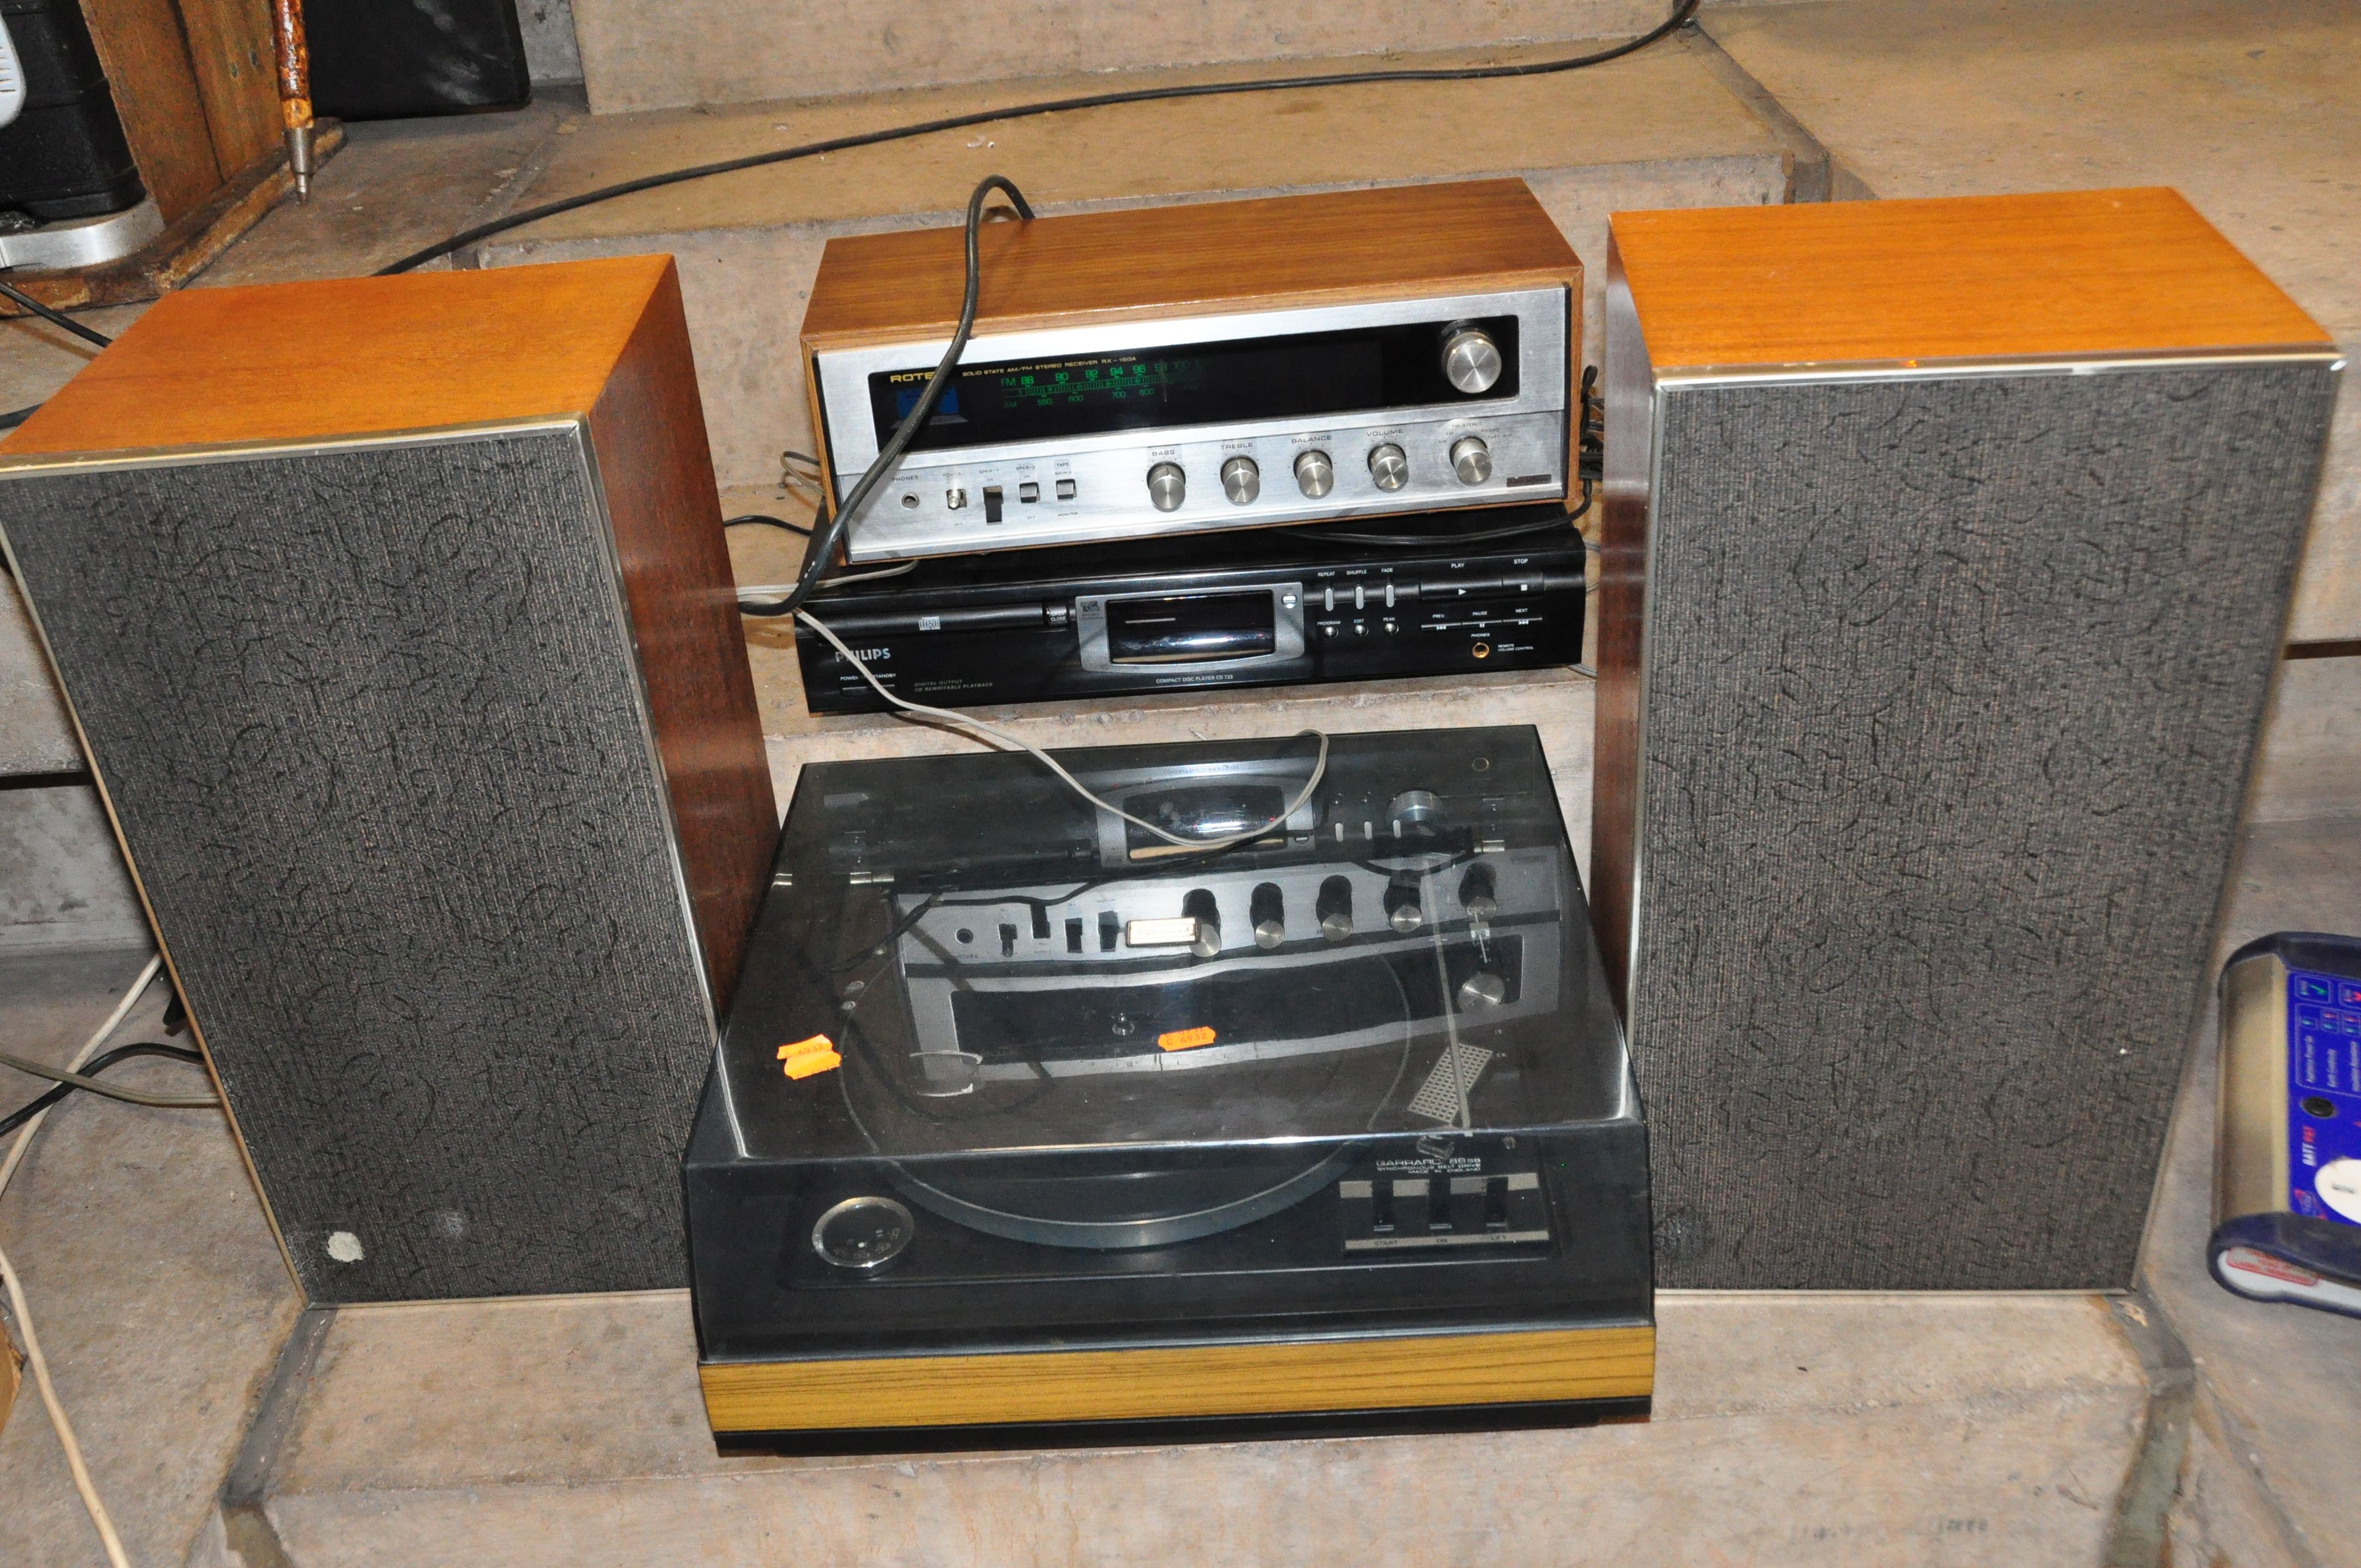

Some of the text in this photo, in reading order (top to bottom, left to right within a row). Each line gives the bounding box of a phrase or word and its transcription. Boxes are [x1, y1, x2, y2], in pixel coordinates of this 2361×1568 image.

[890, 371, 937, 383] ROTE
[1000, 378, 1016, 386] FM
[1020, 375, 1035, 385] 88
[1055, 372, 1069, 382] 90
[1085, 369, 1099, 379] 92
[1109, 366, 1124, 377] 94
[1133, 364, 1146, 374] 96
[1037, 398, 1053, 406] 550
[1111, 390, 1127, 399] 700
[1366, 428, 1405, 437] VOLUME
[1291, 435, 1332, 444] BALANCE
[1180, 1032, 1206, 1044] 6932
